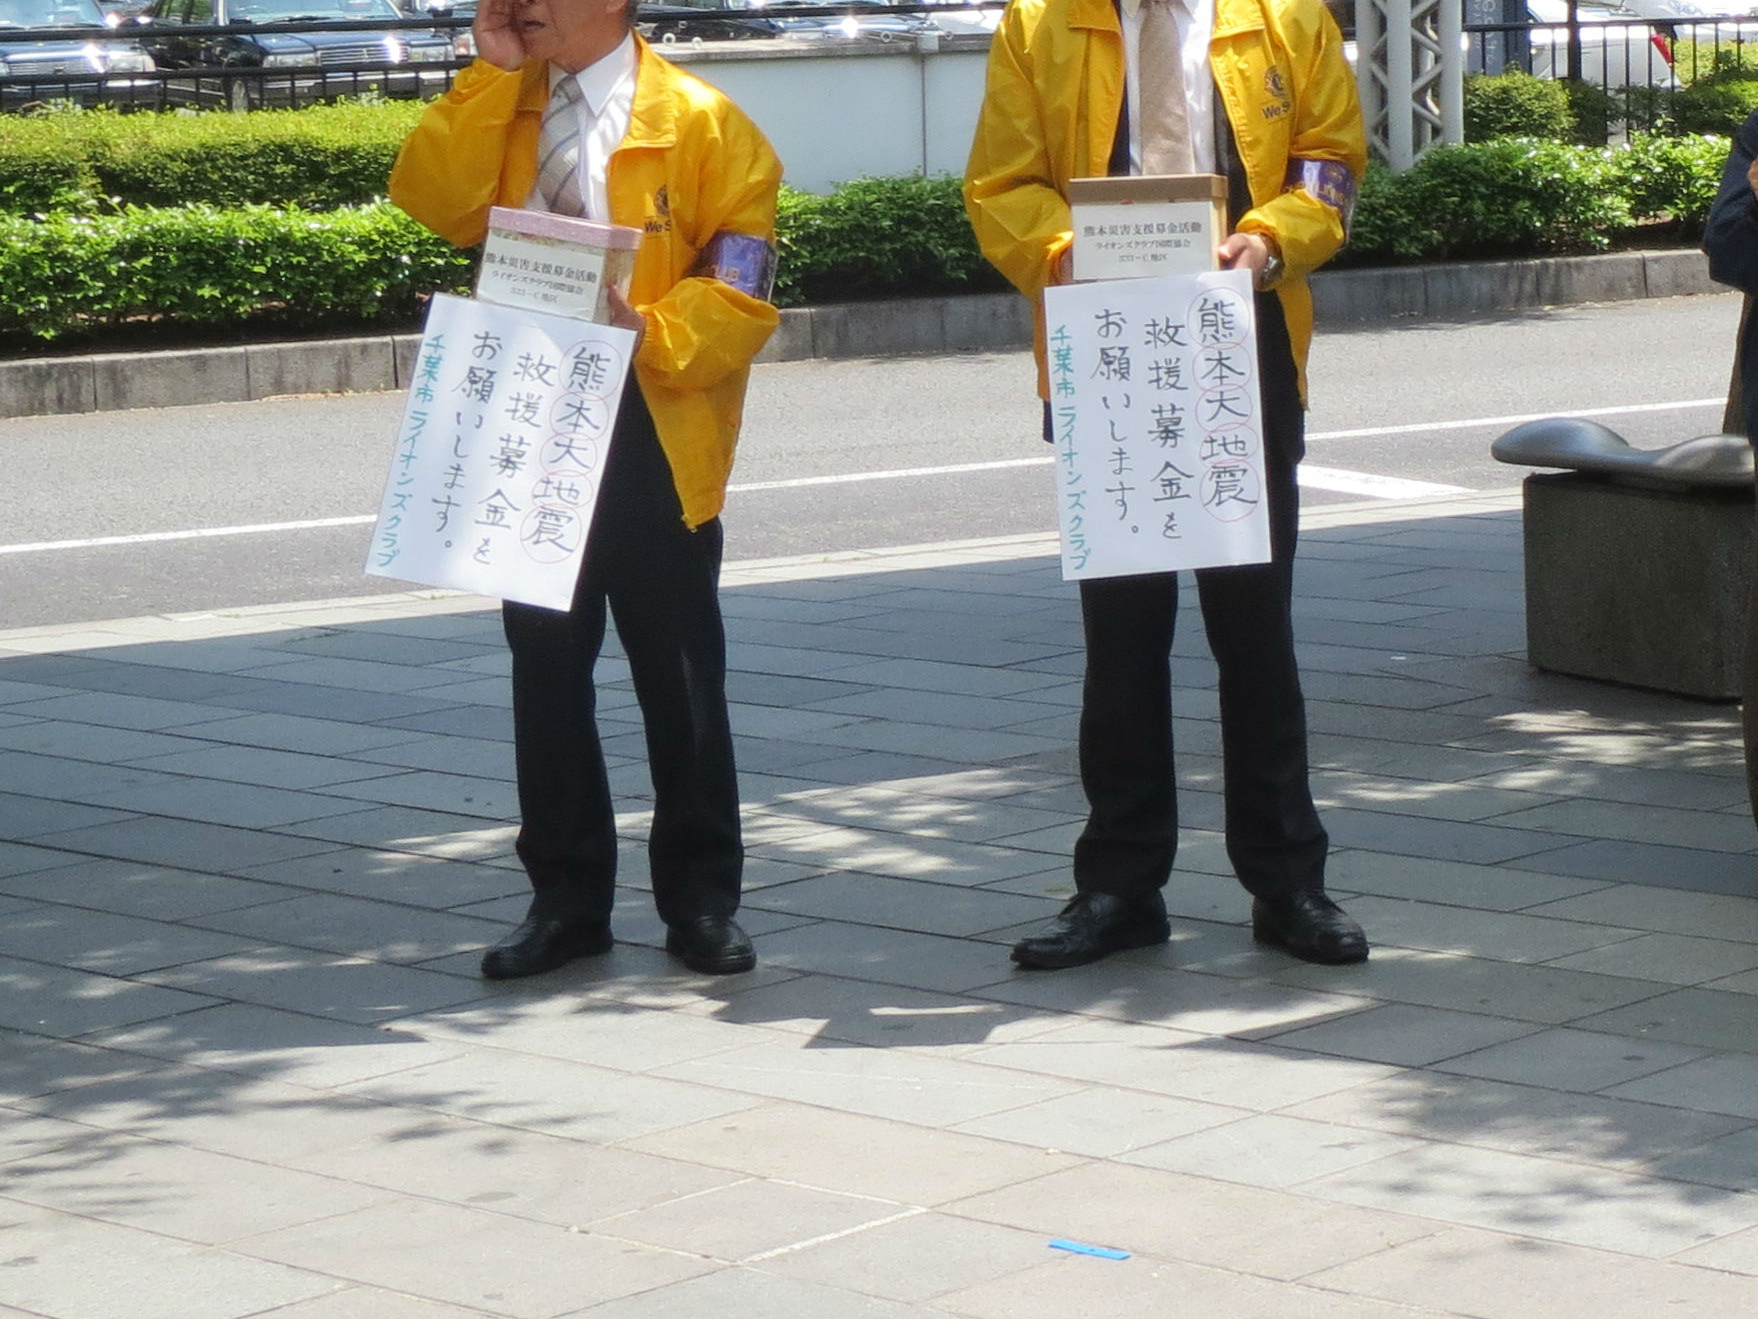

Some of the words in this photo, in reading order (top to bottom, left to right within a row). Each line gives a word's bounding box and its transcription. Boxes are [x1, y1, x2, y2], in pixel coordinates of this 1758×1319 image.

[430, 330, 503, 550] お願いします。
[472, 351, 559, 566] 救援募金を
[523, 346, 612, 555] 熊本大地震
[1089, 307, 1140, 534] お願いします。
[1143, 315, 1195, 540] 救援募金を
[1196, 297, 1258, 508] 熊本大地震
